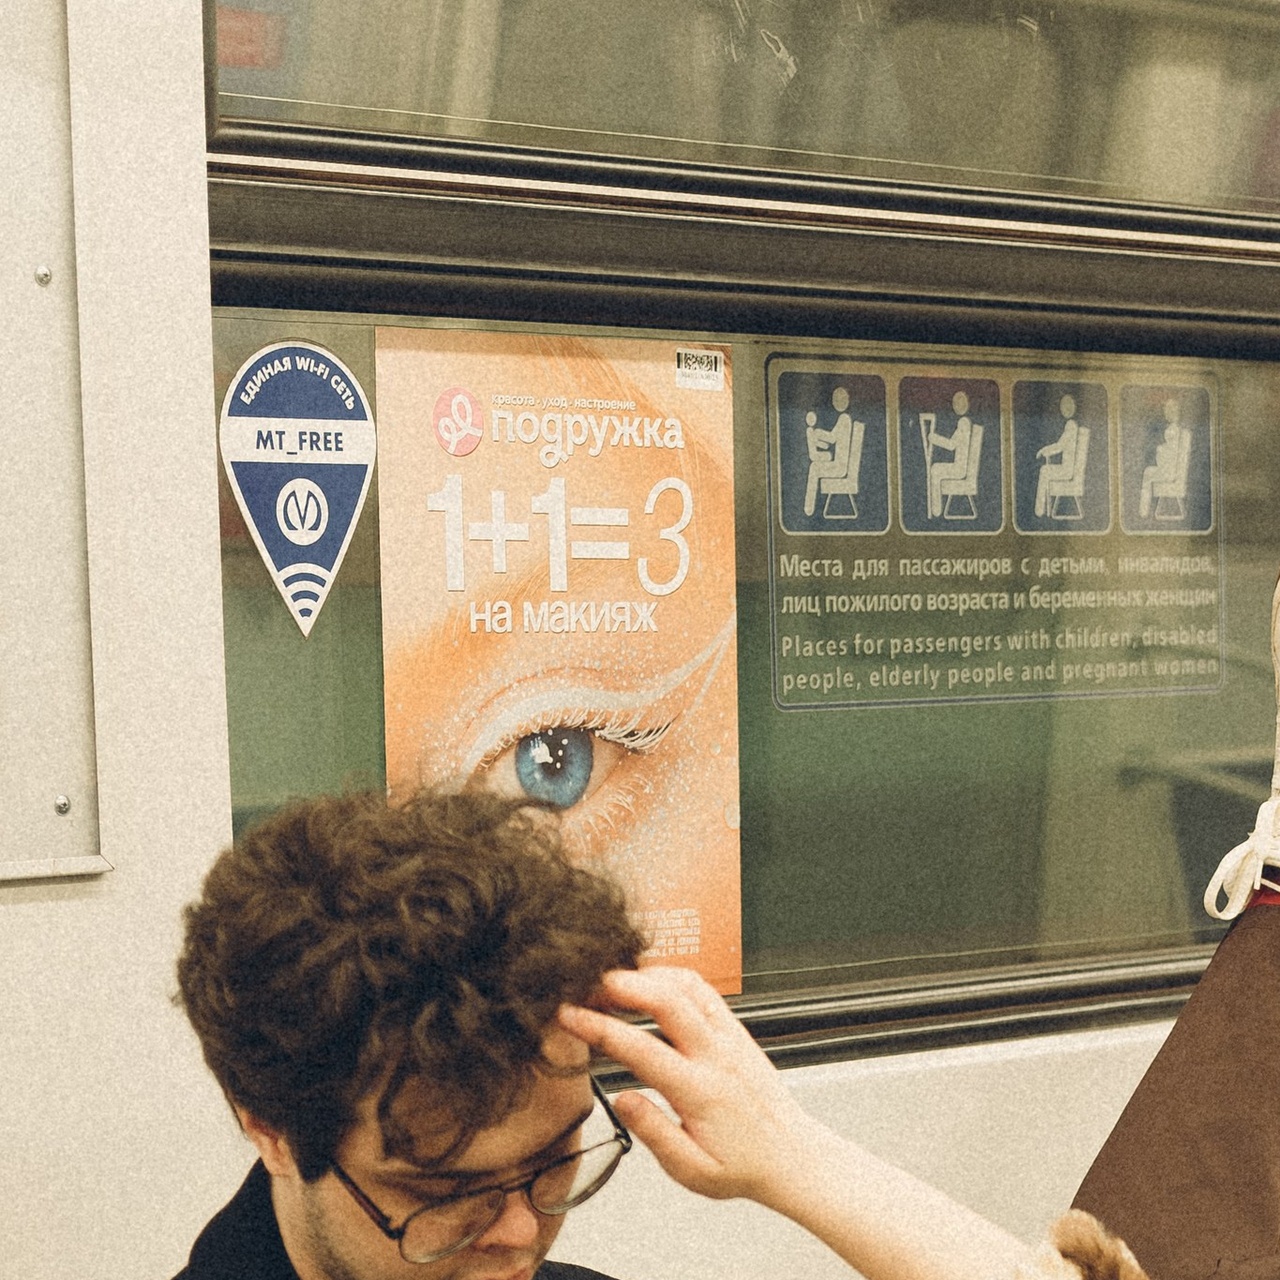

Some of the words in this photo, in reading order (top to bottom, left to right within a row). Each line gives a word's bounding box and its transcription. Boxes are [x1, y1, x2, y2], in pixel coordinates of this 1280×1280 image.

[240, 356, 292, 405] ЕДИНАЯ
[295, 355, 330, 380] WI-FI
[330, 374, 355, 410] СЕТЬ
[491, 394, 536, 407] красота
[541, 396, 567, 411] уход
[574, 398, 637, 412] настроение
[256, 429, 344, 455] MT_FREE
[491, 409, 685, 468] подружка
[427, 474, 694, 597] 1+1=3
[779, 554, 843, 577] Места
[852, 558, 890, 581] для
[899, 556, 1012, 581] пассажиров
[1020, 558, 1030, 575] с
[469, 600, 513, 633] на
[522, 600, 659, 633] макияж
[781, 594, 820, 617] лиц
[825, 593, 923, 613] пожилого
[926, 592, 1009, 616] возраста
[1013, 592, 1025, 609] и
[1029, 585, 1143, 614] беременных
[1145, 588, 1216, 608] женщин
[781, 635, 848, 657] Places
[853, 633, 884, 655] for
[890, 631, 1001, 659] passengers
[1006, 629, 1050, 651] with
[1055, 626, 1138, 650] children,
[1141, 624, 1218, 646] disabled
[783, 666, 861, 696] people,
[869, 663, 940, 690] elderly
[948, 661, 1014, 689] people
[1021, 661, 1056, 682] and
[1062, 660, 1147, 685] pregnant
[1154, 659, 1218, 676] women
